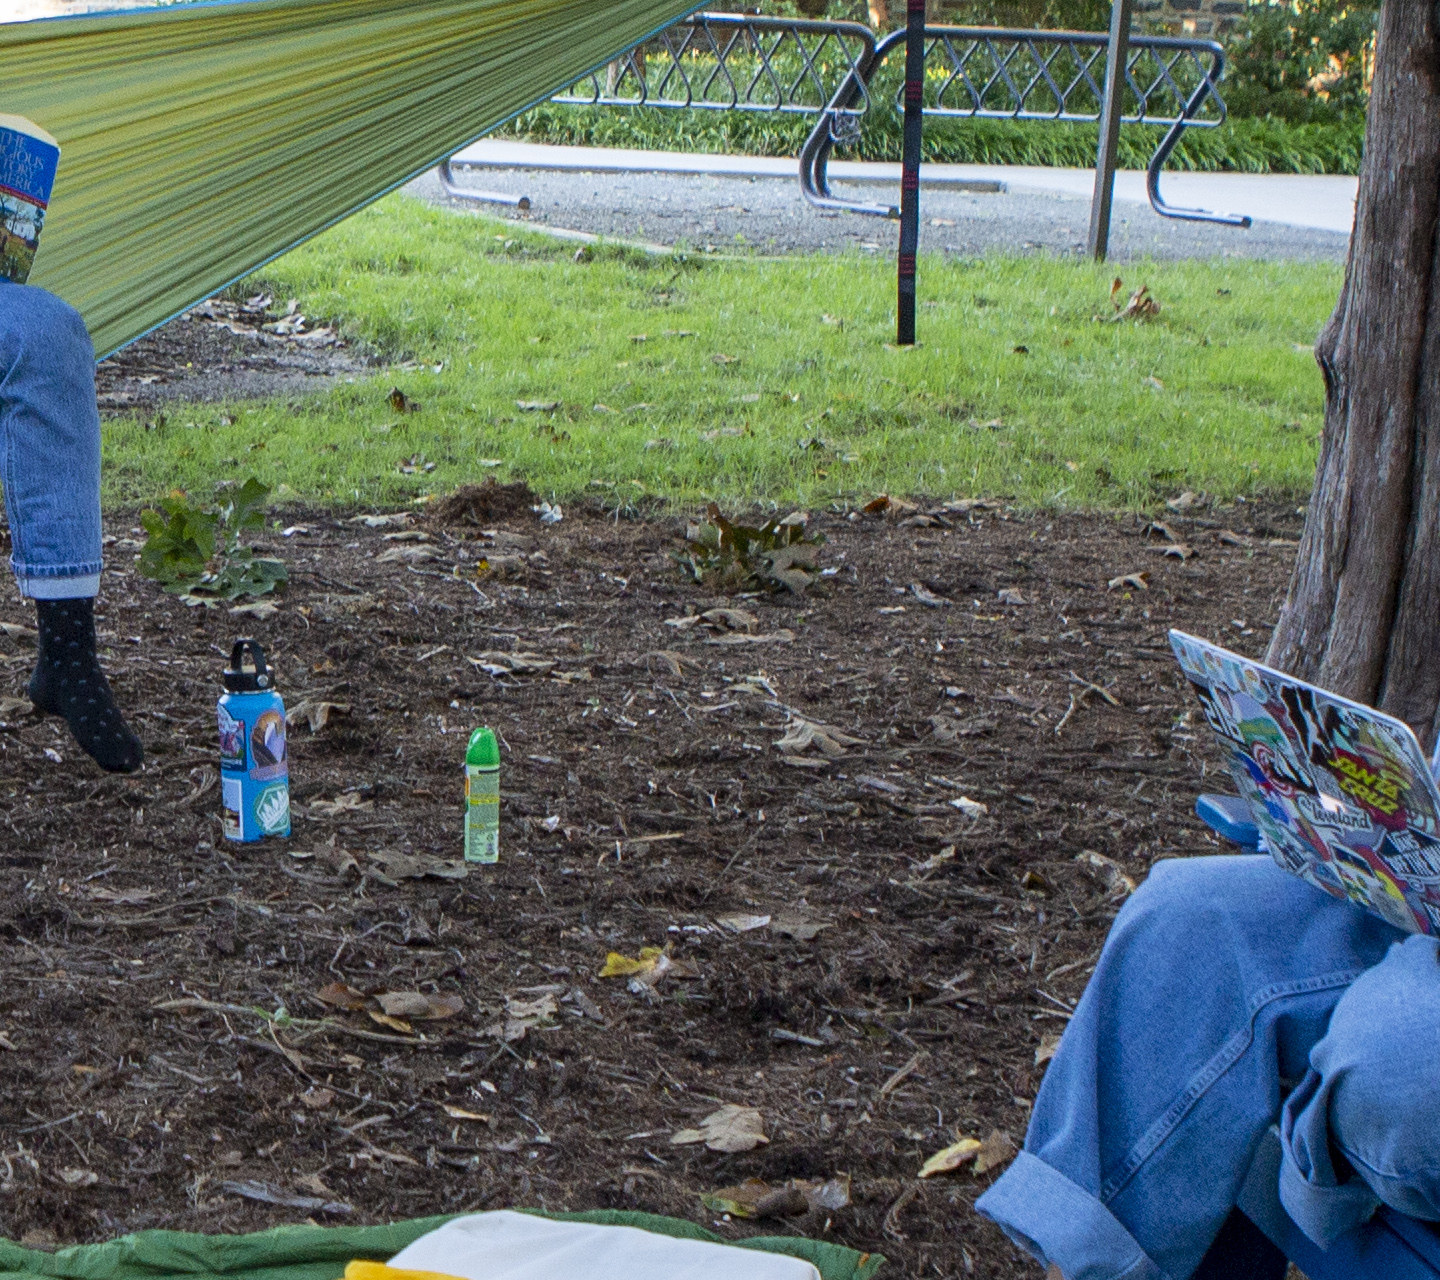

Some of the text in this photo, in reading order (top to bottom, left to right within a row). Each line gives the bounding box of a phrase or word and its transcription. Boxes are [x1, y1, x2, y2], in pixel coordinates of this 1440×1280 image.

[1328, 756, 1398, 801] SANTA
[1340, 777, 1400, 816] CRUZ
[1299, 796, 1369, 831] Cleveland
